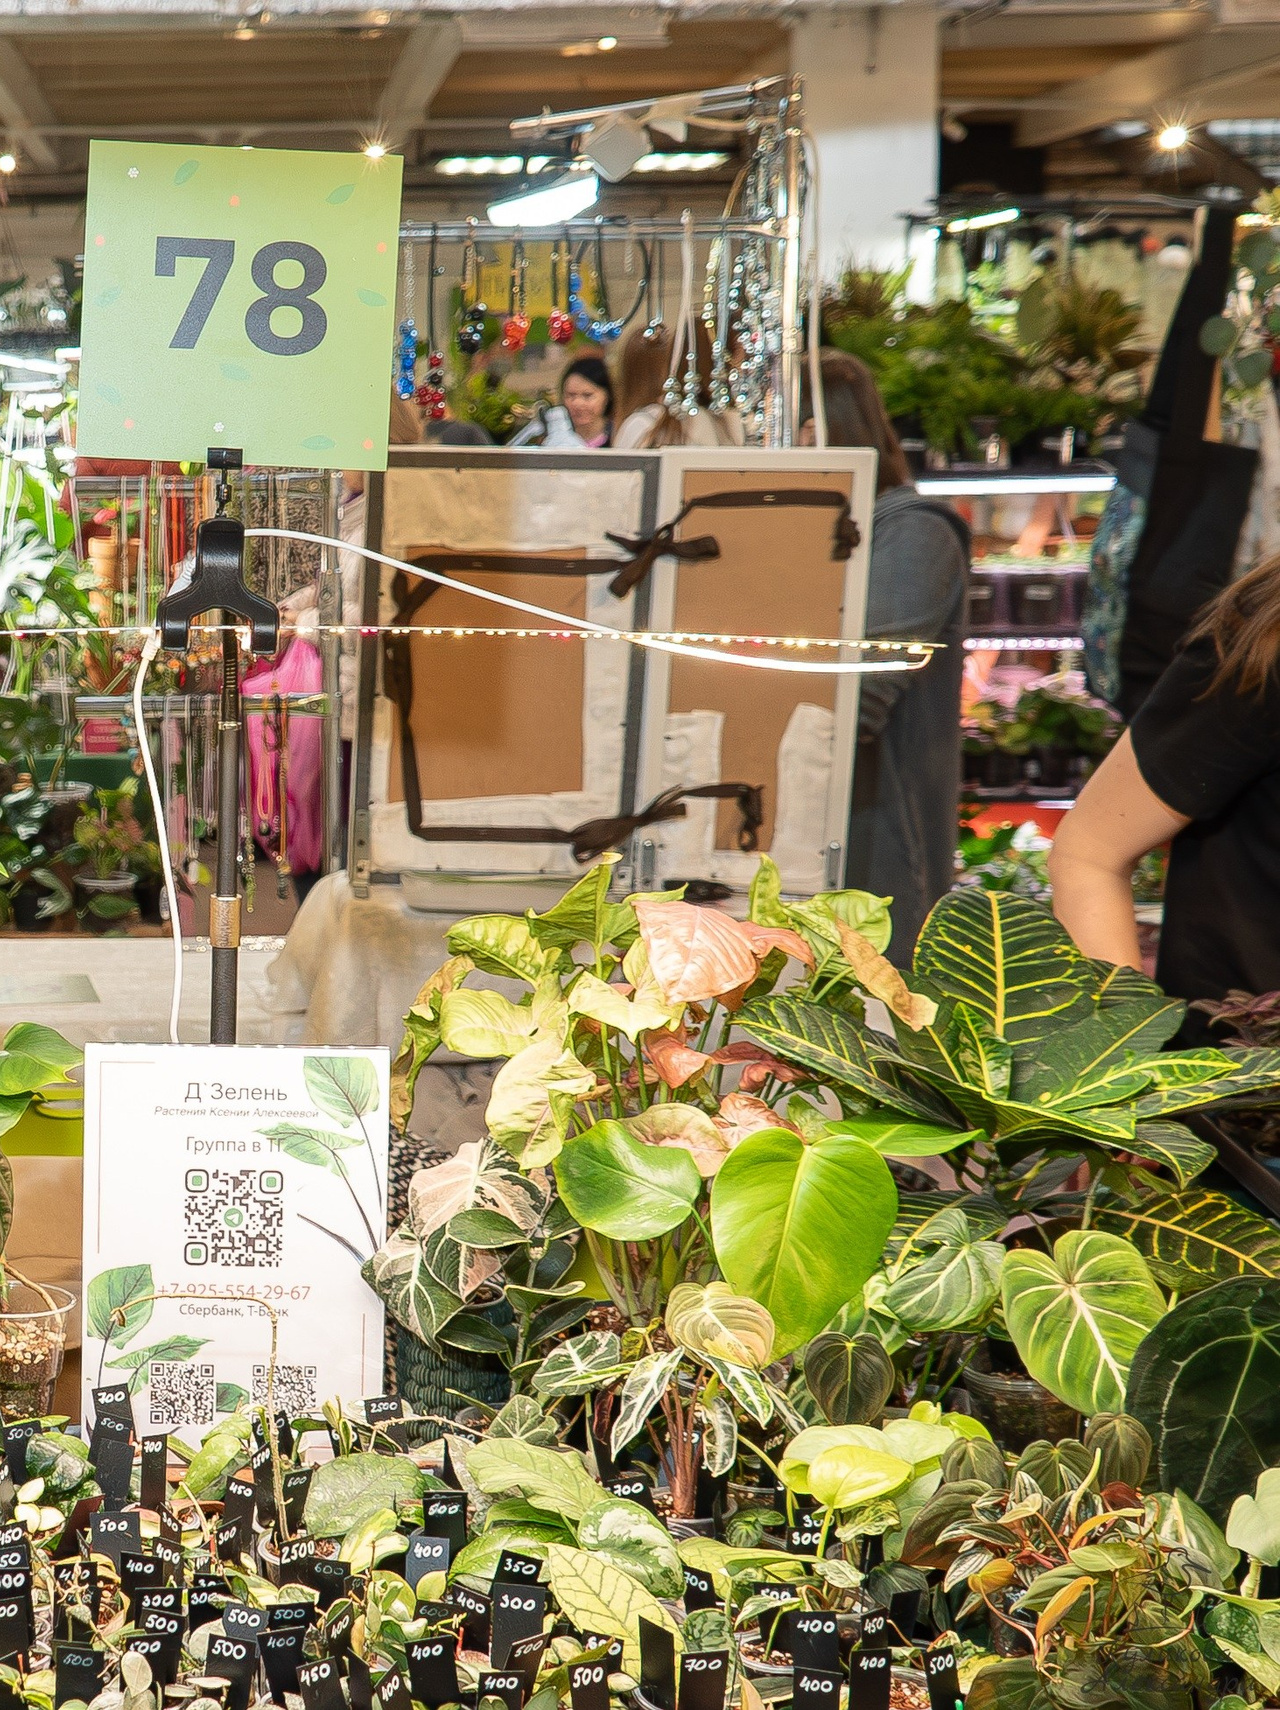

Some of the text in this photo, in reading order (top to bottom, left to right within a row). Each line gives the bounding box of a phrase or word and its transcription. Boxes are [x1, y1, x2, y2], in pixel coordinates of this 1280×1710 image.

[154, 236, 328, 356] 78
[154, 1105, 320, 1119] Растения Ксении Алексеевой
[186, 1136, 246, 1156] Группа
[252, 1140, 262, 1152] в
[178, 1303, 244, 1318] Сбербанк,
[97, 1390, 126, 1405] 700
[370, 1401, 398, 1413] 2500
[7, 1426, 34, 1441] 500
[143, 1440, 163, 1454] 700
[228, 1481, 253, 1498] 450
[286, 1475, 308, 1488] 600
[99, 1518, 129, 1533] 500
[155, 1542, 181, 1565] 400
[280, 1540, 316, 1565] 2500
[412, 1542, 444, 1559] 400
[125, 1559, 155, 1574] 400
[313, 1561, 345, 1576] 600
[502, 1557, 538, 1576] 350
[141, 1593, 175, 1608] 300
[455, 1591, 487, 1615] 400
[228, 1608, 261, 1628] 500
[273, 1609, 306, 1620] 500
[419, 1604, 450, 1618] 600
[145, 1613, 179, 1634] 500
[330, 1614, 351, 1640] 400
[796, 1619, 836, 1634] 400
[863, 1616, 885, 1634] 450
[211, 1639, 247, 1660] 500
[266, 1636, 297, 1649] 400
[514, 1639, 544, 1658] 500
[411, 1644, 444, 1661] 400
[684, 1658, 723, 1673] 700
[859, 1656, 887, 1671] 400
[929, 1653, 955, 1676] 500
[300, 1662, 331, 1687] 450
[484, 1675, 519, 1690] 400
[572, 1666, 605, 1689] 500
[380, 1674, 401, 1703] 400
[799, 1675, 834, 1693] 400
